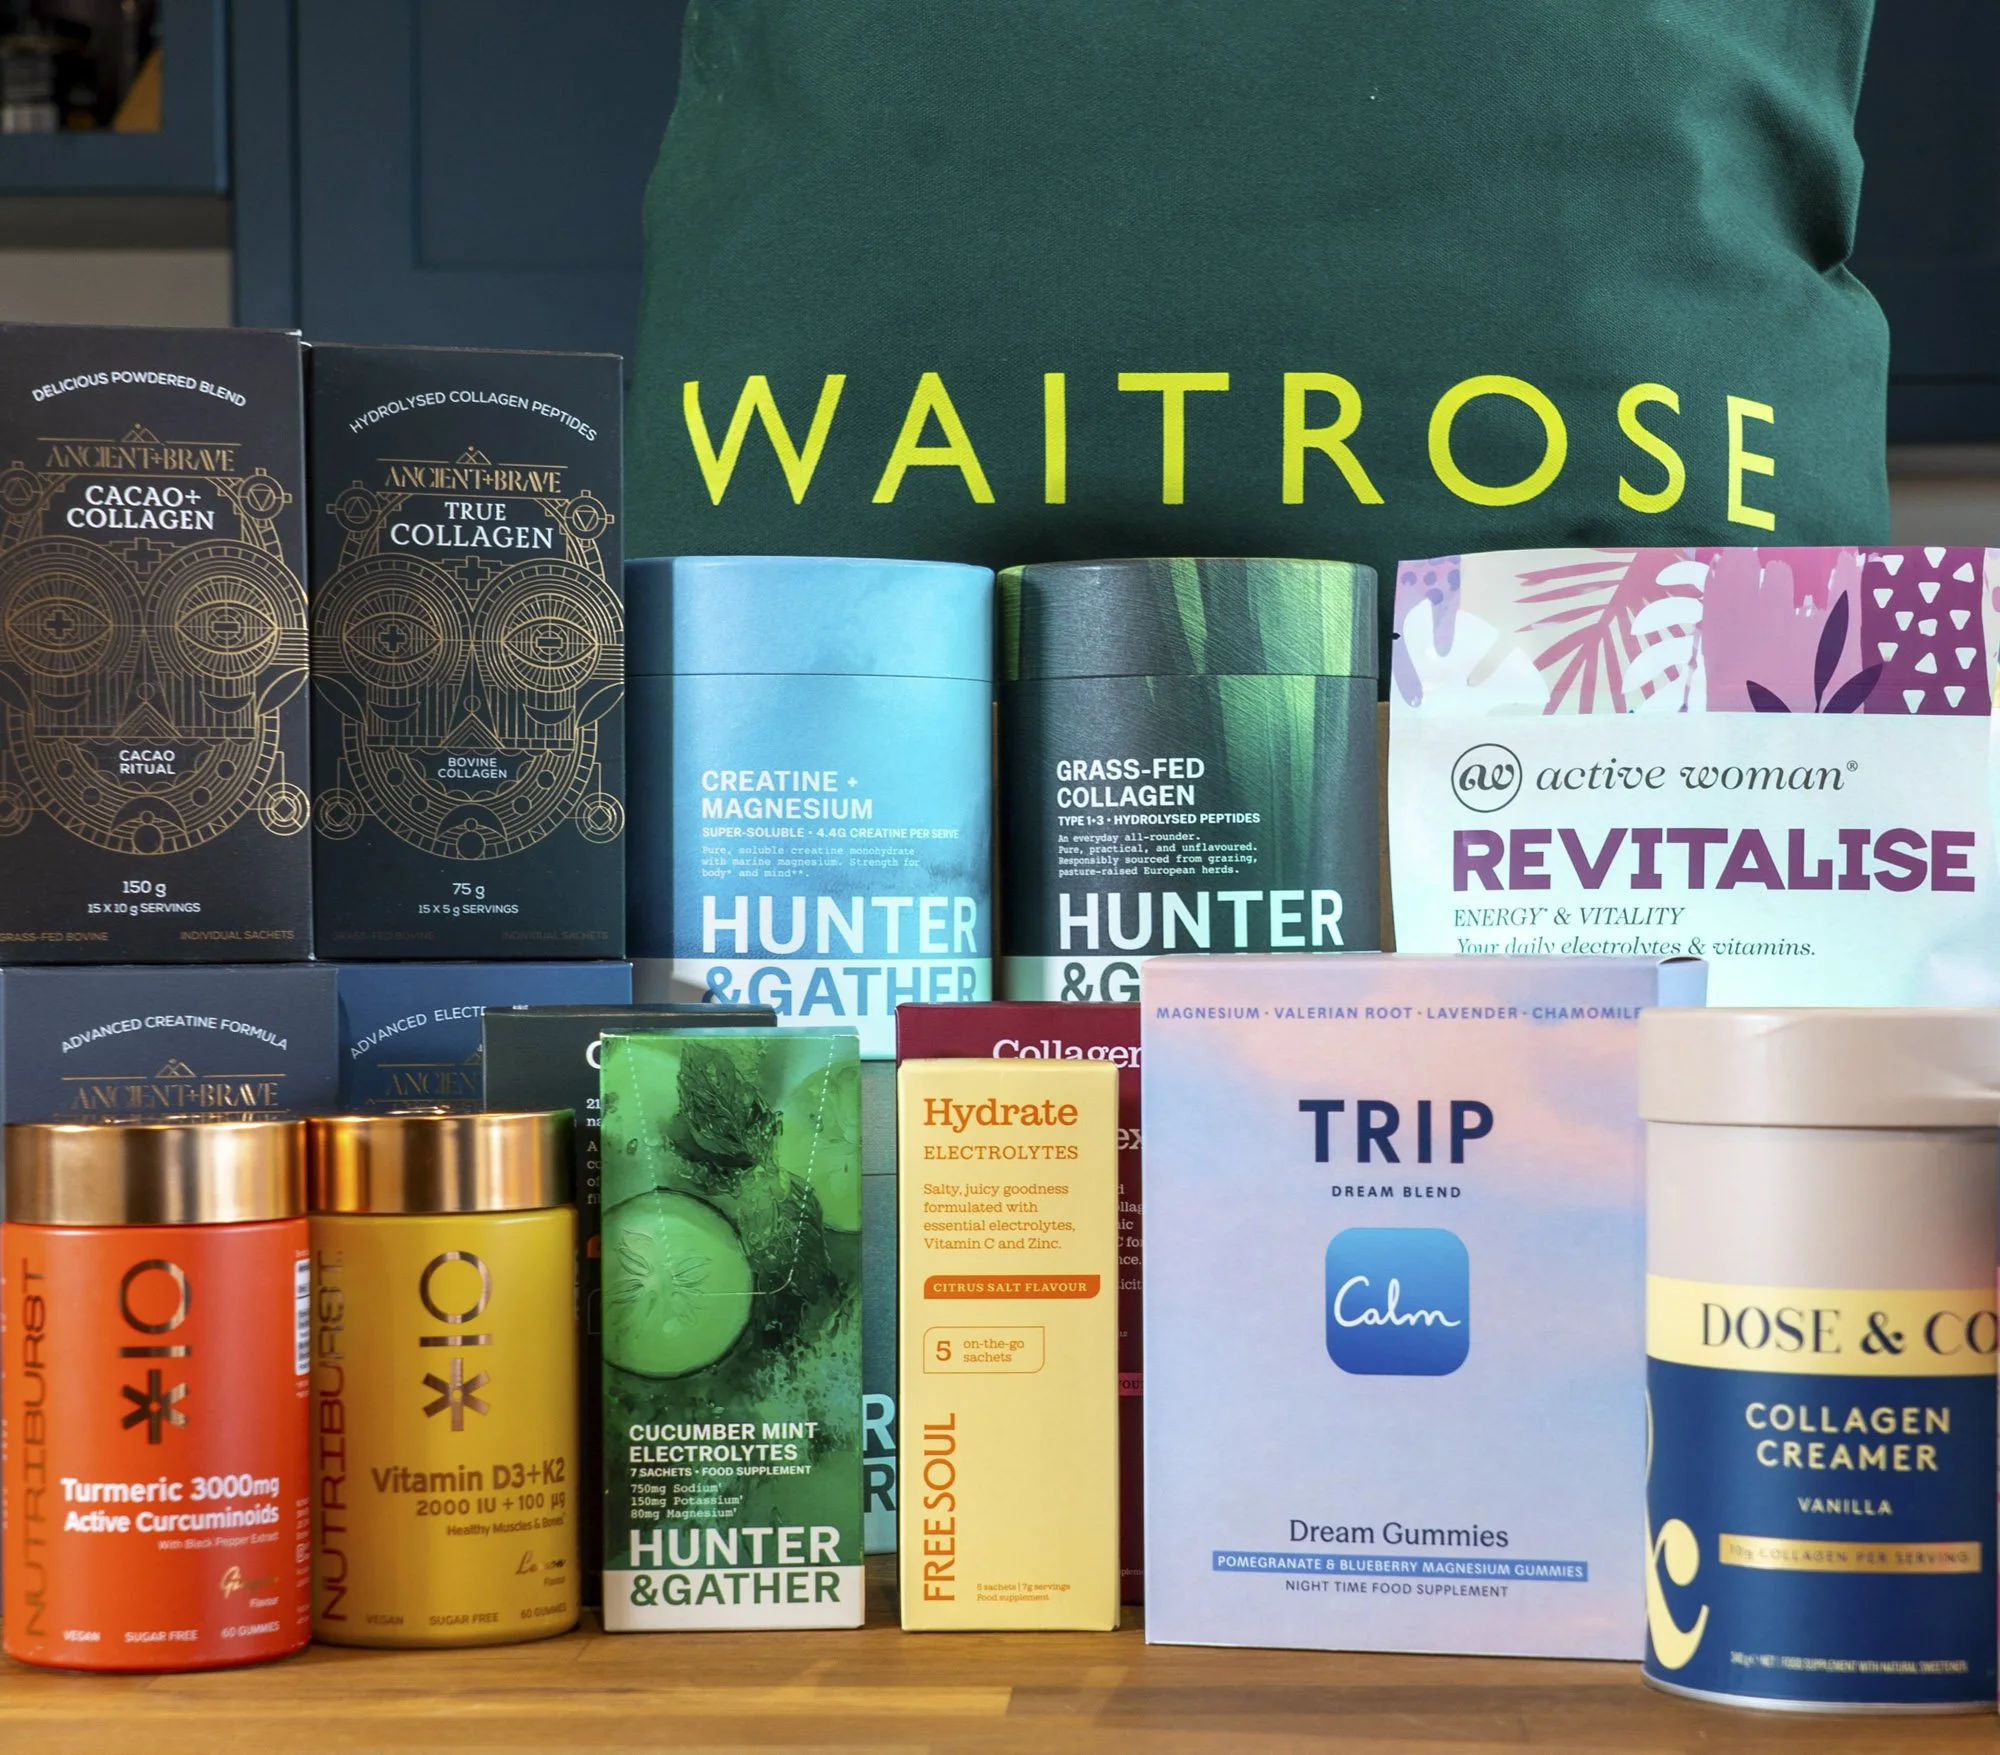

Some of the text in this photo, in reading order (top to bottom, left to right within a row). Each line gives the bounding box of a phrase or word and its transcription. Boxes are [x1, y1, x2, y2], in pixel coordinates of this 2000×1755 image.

[32, 371, 247, 407] DELICIOUS POWDERED BLEND
[350, 390, 597, 442] HYDROLYSED COLLAGEN PEPTIDES
[684, 372, 1775, 531] WAITROSE
[85, 485, 202, 507] CACAO+
[66, 508, 216, 530] COLLAGEN
[444, 501, 507, 521] TRUE
[390, 523, 554, 549] COLLAGEN
[119, 750, 175, 762] CACAO
[448, 757, 497, 768] BOVINE
[119, 763, 176, 775] RITUAL
[438, 769, 508, 779] COLLAGEN
[1056, 758, 1205, 782] GRASS-FED
[1536, 758, 1666, 791] active
[701, 770, 838, 792] CREATINE
[1057, 785, 1195, 808] COLLAGEN
[702, 798, 873, 819] MAGNESIUM
[1058, 816, 1085, 826] TYPE
[1114, 813, 1197, 825] HYDROLYSED
[1200, 812, 1261, 824] PEPTIDES
[702, 827, 959, 839] SUPER-SOLUBLE 4.4G CREATINE PER SERVE
[1073, 832, 1201, 846] everyday all-rounder.
[738, 845, 915, 857] soluble creatine monohydrate
[1058, 842, 1258, 855] Pure, practical, and unflavoured.
[732, 858, 898, 869] marine magnesium. Strength
[1058, 854, 1258, 867] Responsibly sourced from grazing,
[1453, 827, 1976, 892] REVITALISE
[1058, 865, 1240, 878] pasture-raised European herds.
[122, 880, 167, 898] 150 g
[452, 882, 485, 899] 75 g
[140, 903, 201, 913] SERVINGS
[462, 904, 519, 914] SERVINGS
[1553, 907, 1572, 926] &
[1579, 907, 1685, 926] VITALITY
[702, 895, 978, 954] HUNTER
[1059, 889, 1345, 950] HUNTER
[1458, 937, 1501, 955] Your
[1560, 937, 1681, 956] electrolytes
[1688, 937, 1704, 955] &
[1713, 937, 1815, 956] vitamins.
[1156, 1007, 1260, 1019] MAGNESIUM
[1274, 1007, 1357, 1019] VALERIAN
[1365, 1007, 1412, 1019] ROOT
[1427, 1007, 1518, 1019] LAVENDER
[61, 1015, 287, 1053] ADVANCED CREATINE FORMULA
[350, 1013, 427, 1060] ADVANCED
[923, 1098, 1078, 1133] Hydrate
[1299, 1099, 1494, 1164] TRIP
[924, 1145, 1078, 1160] ELECTROLYTES
[923, 1183, 1069, 1199] Salty, juicy goodness
[1331, 1185, 1462, 1198] DREAM BLEND
[923, 1202, 1038, 1213] formulated with
[923, 1219, 1076, 1234] essential electrolytes,
[924, 1237, 1062, 1250] Vitamin C and Zinc.
[933, 1281, 1088, 1293] CITRUS SALT FLAVOUR
[1333, 1275, 1461, 1327] Calm
[1701, 1302, 1842, 1354] DOSE
[1860, 1311, 1906, 1355] &
[936, 1338, 1025, 1361] 5 on-the-go
[963, 1350, 1012, 1363] sachets
[1745, 1402, 1951, 1434] COLLAGEN
[629, 1422, 818, 1441] CUCUMBER MINT
[629, 1444, 798, 1463] ELECTROLYTES
[1756, 1439, 1938, 1471] CREAMER
[372, 1456, 565, 1493] Vitamin D3+K2
[630, 1465, 812, 1477] 7 SACHETS FOOD SUPPLEMENT
[61, 1474, 280, 1503] Turmeric 3000mg
[630, 1484, 667, 1495] 750mg
[416, 1493, 545, 1516] 2000 IU 100
[630, 1496, 667, 1507] 150mg
[1798, 1497, 1893, 1515] VANILLA
[64, 1503, 279, 1533] Active Curcuminoids
[630, 1509, 659, 1520] 80mg
[446, 1521, 532, 1537] Healthy Muscles
[1289, 1519, 1509, 1547] Dream Gummies
[630, 1526, 841, 1567] HUNTER
[1760, 1549, 1970, 1565] COLLAGEN PER SERVING
[1217, 1556, 1583, 1578] POMEGRANATE BLUEBERRY MAGNESIUM GUMMIES
[630, 1571, 841, 1606] &GATHER
[1285, 1580, 1508, 1597] NIGHT TIME FOOD SUPPLEMENT
[124, 1630, 199, 1643] SUGAR FREE
